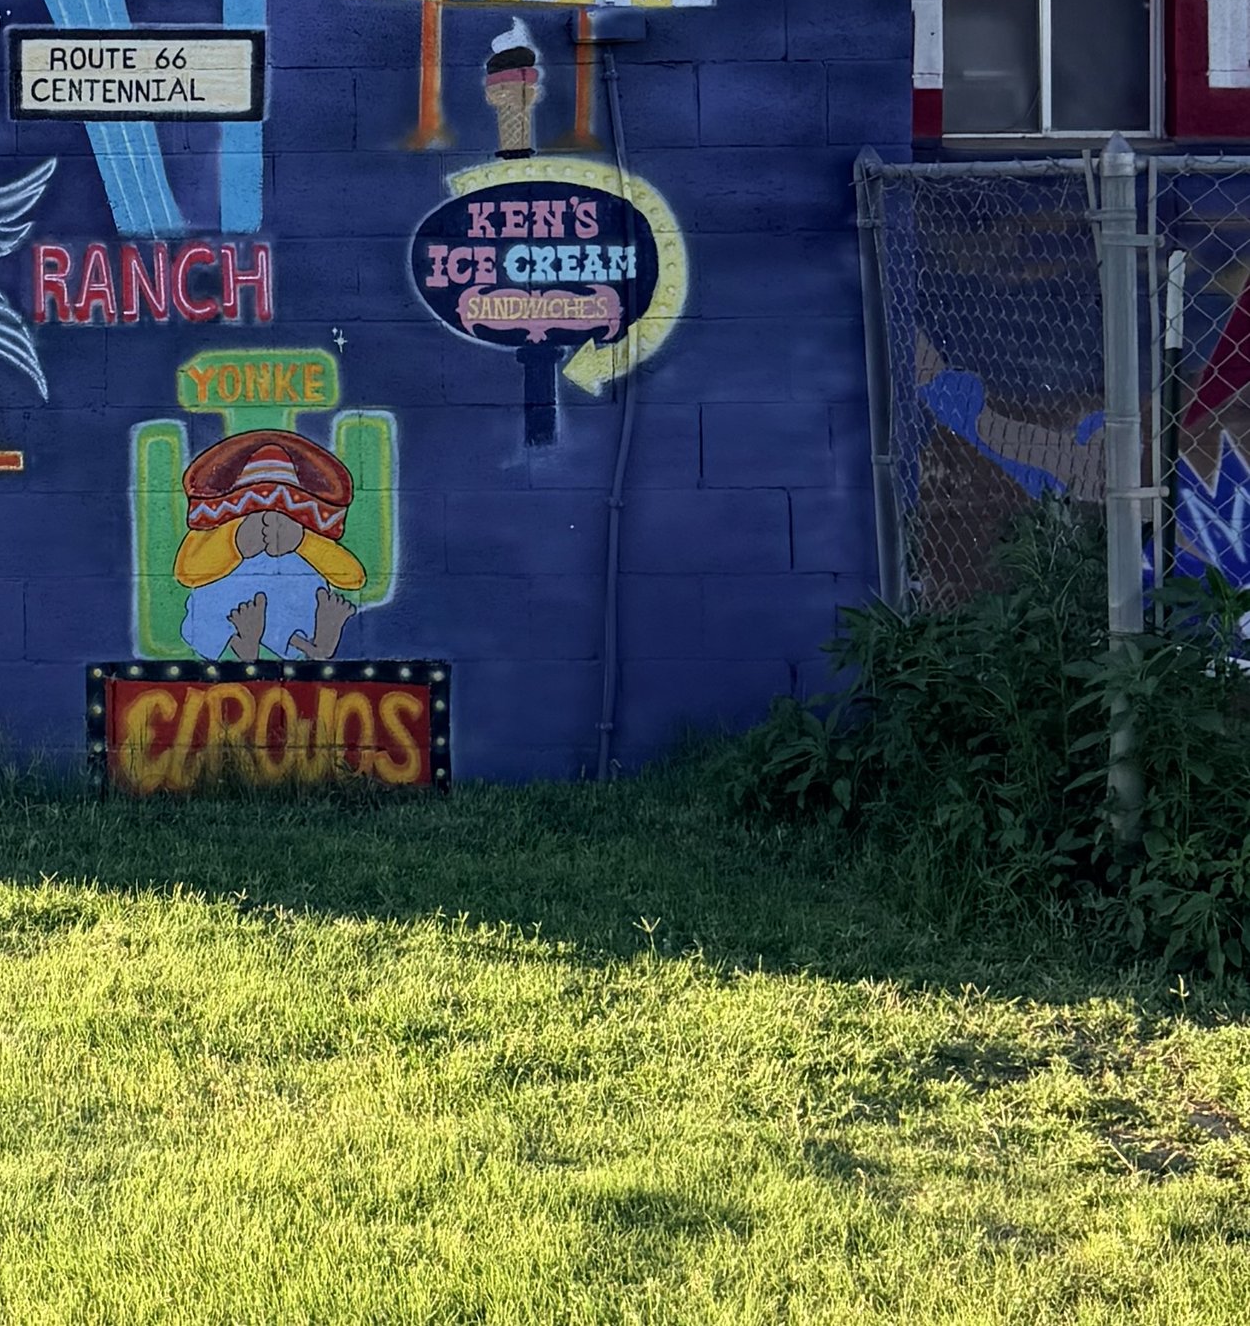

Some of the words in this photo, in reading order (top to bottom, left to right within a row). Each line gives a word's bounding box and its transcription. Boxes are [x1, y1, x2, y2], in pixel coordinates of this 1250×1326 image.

[50, 47, 138, 70] ROUTE
[155, 48, 188, 69] 66
[30, 77, 206, 104] CENTENNIAL
[467, 196, 600, 239] KEN'S
[33, 243, 273, 324] RANCH
[425, 244, 498, 288] ICE
[503, 244, 638, 283] CREAM
[466, 296, 609, 320] SANDWICHES
[187, 363, 327, 403] YONKE
